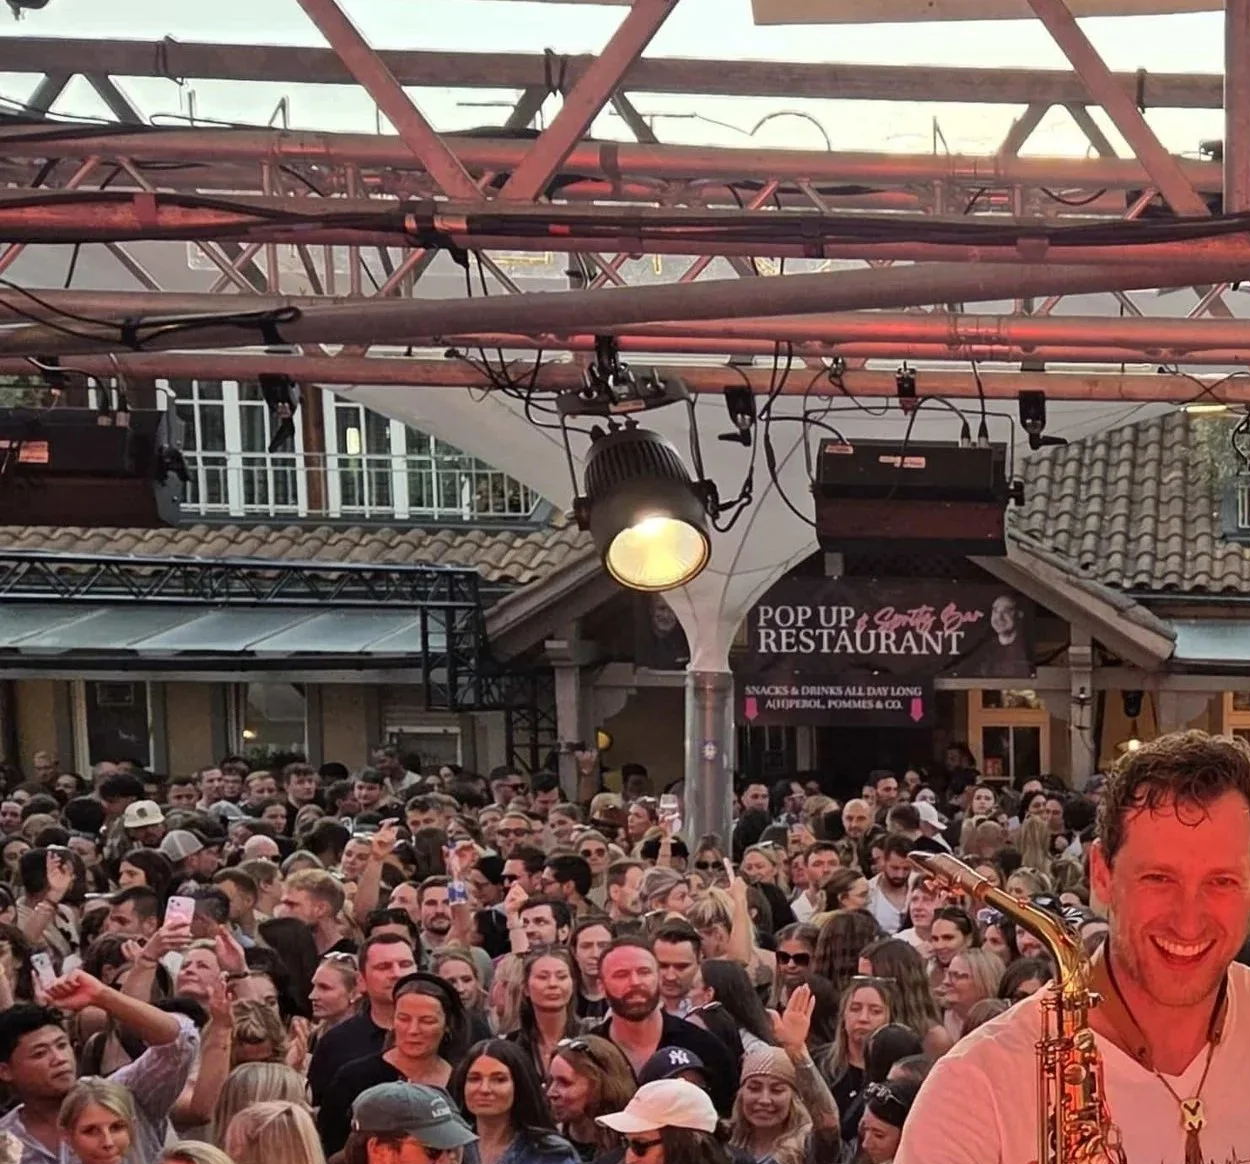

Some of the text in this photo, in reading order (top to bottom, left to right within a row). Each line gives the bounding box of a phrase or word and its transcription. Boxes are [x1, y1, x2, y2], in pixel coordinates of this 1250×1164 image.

[758, 605, 855, 627] POP UP
[758, 628, 964, 655] RESTAURANT
[745, 685, 922, 697] SNACKS & DRINKS ALL DAY LONG
[827, 700, 874, 710] POMMES
[875, 701, 884, 710] &
